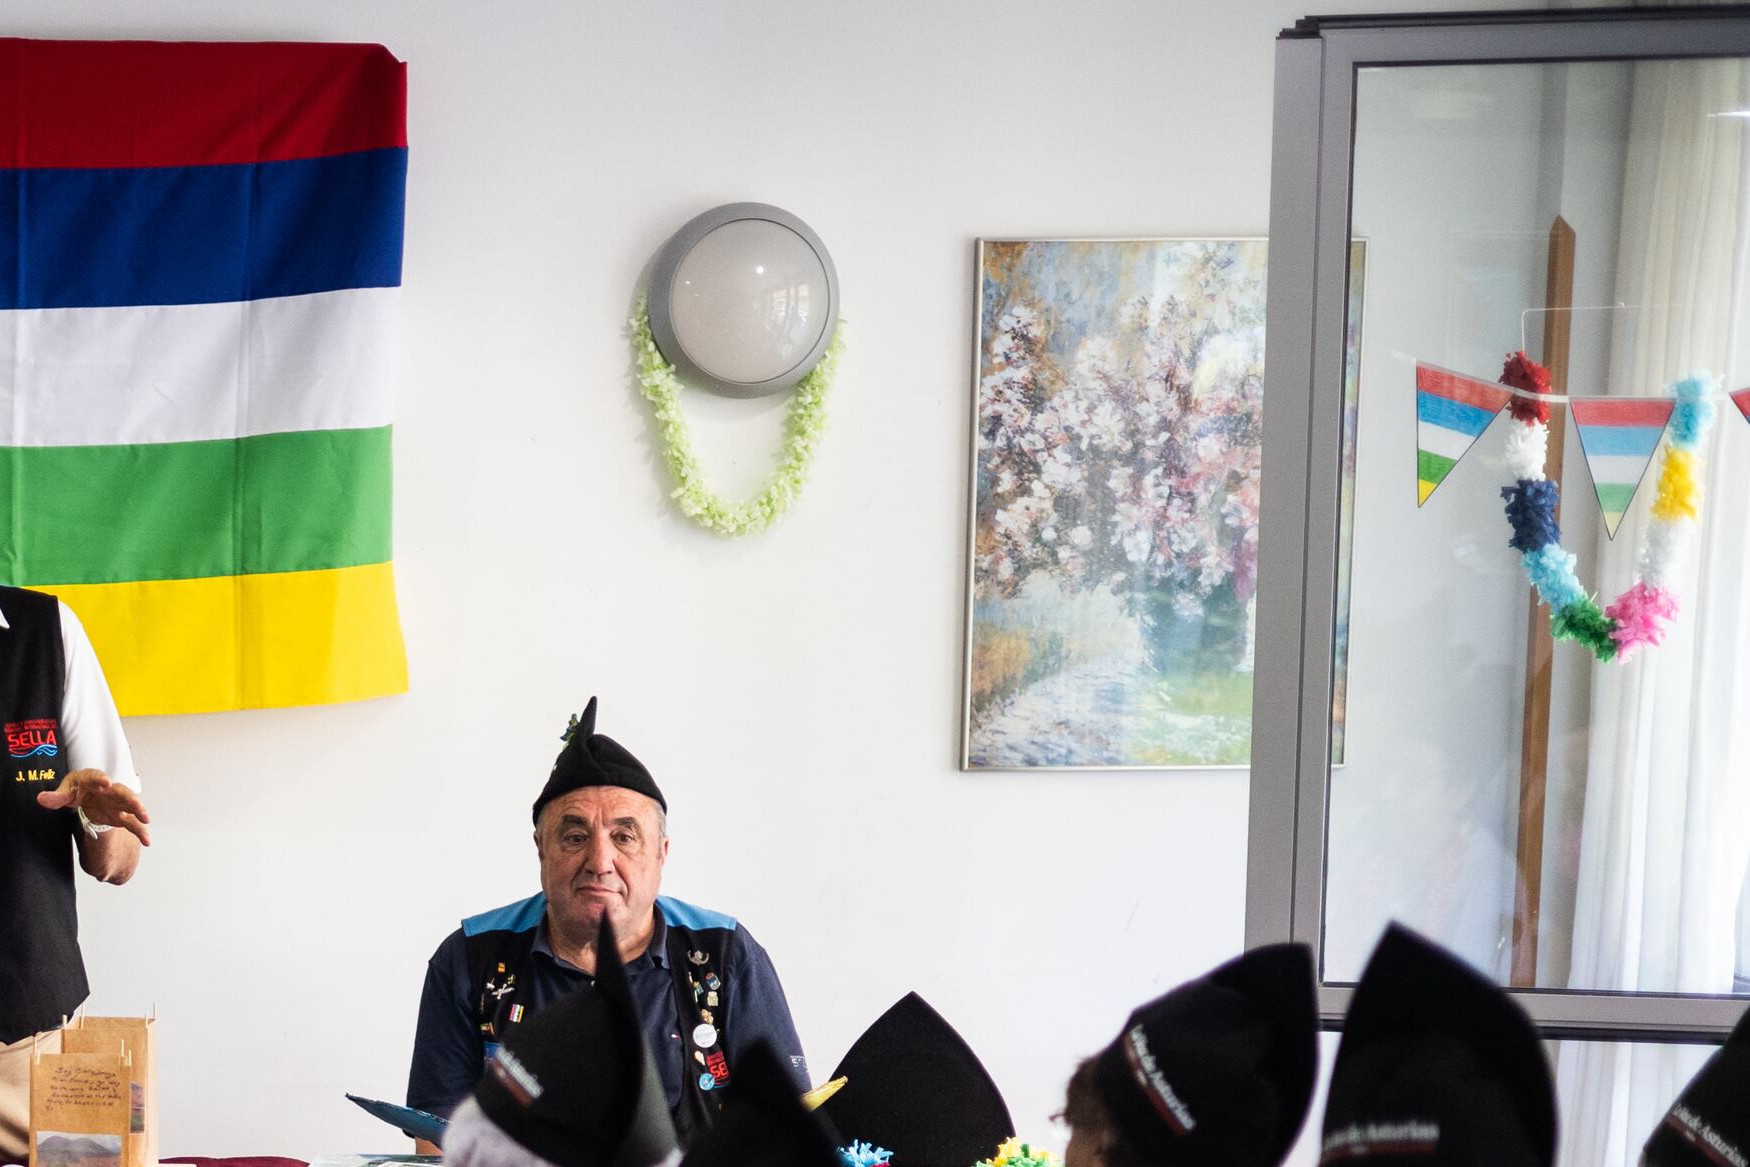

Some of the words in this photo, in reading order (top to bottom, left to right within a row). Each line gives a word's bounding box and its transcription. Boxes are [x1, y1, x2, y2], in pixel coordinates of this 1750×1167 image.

[7, 730, 56, 747] SELLA
[16, 770, 25, 781] J.
[28, 769, 39, 781] M.
[709, 1061, 728, 1078] SE
